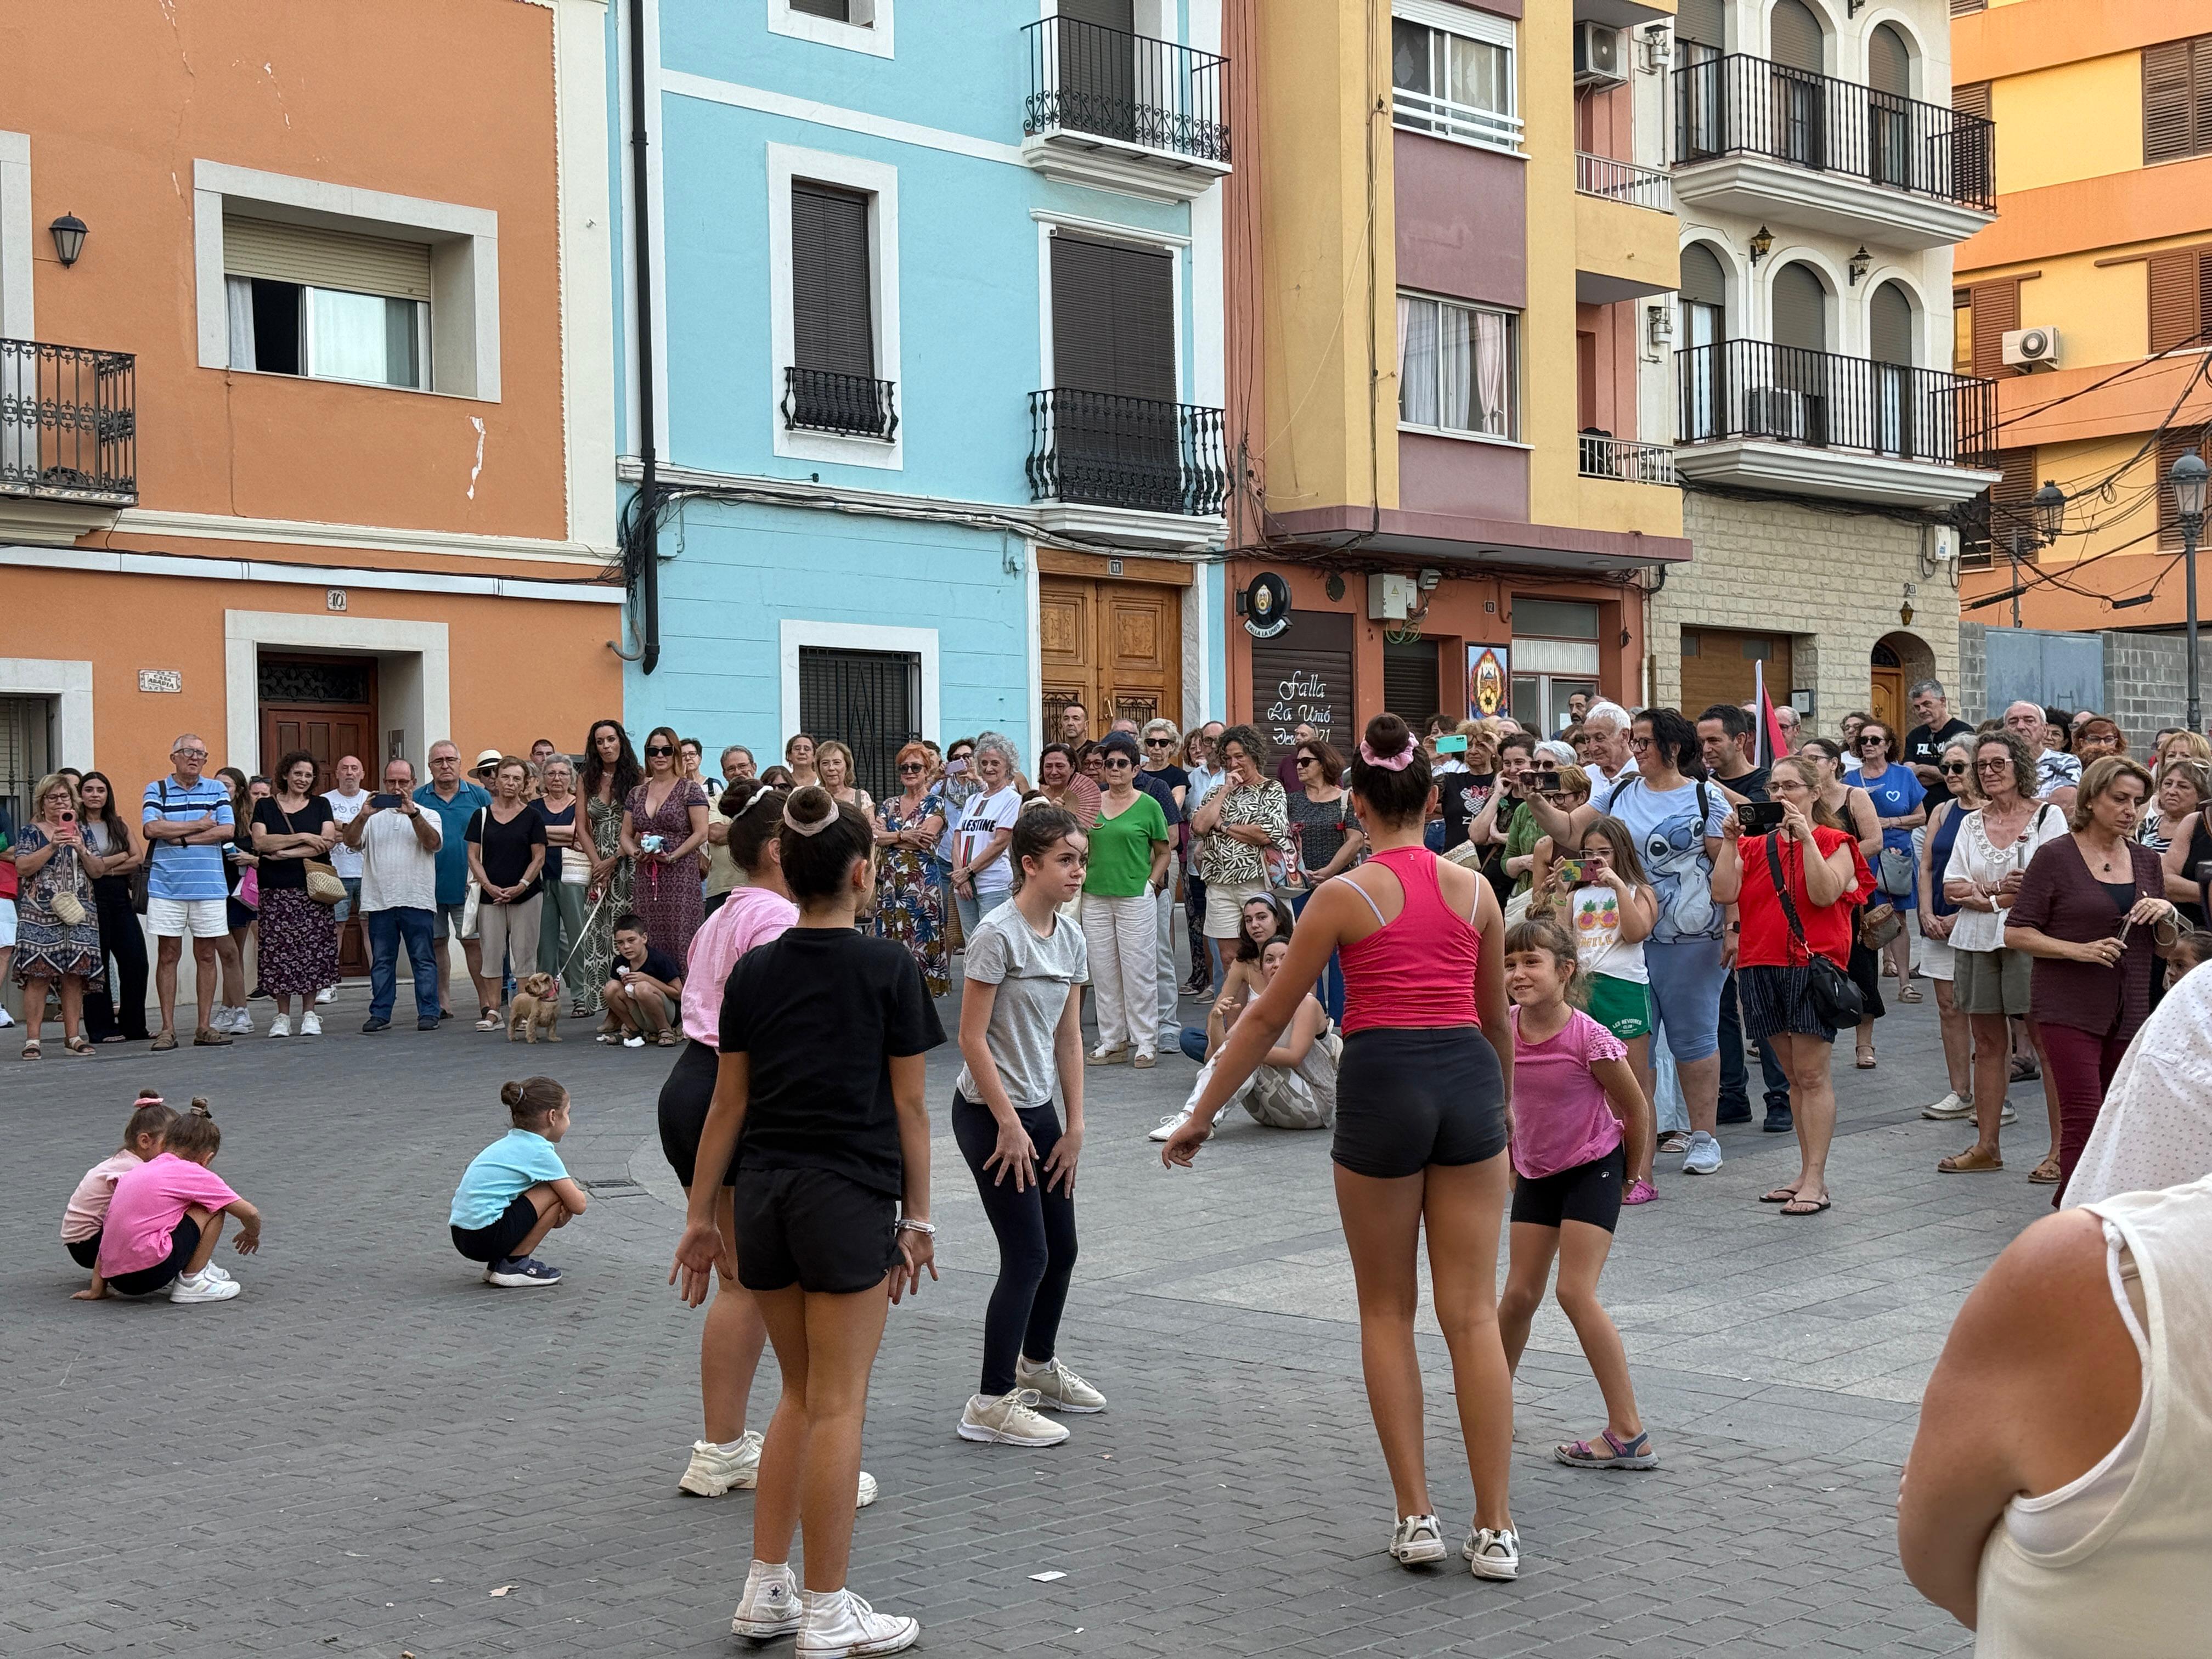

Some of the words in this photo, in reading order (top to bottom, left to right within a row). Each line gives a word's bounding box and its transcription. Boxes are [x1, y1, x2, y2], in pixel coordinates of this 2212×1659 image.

[330, 592, 343, 607] 10
[1247, 624, 1261, 636] FALLA
[1267, 701, 1293, 721] La
[1273, 727, 1296, 745] Des
[962, 819, 997, 832] LESTINE
[1579, 934, 1614, 948] MILE
